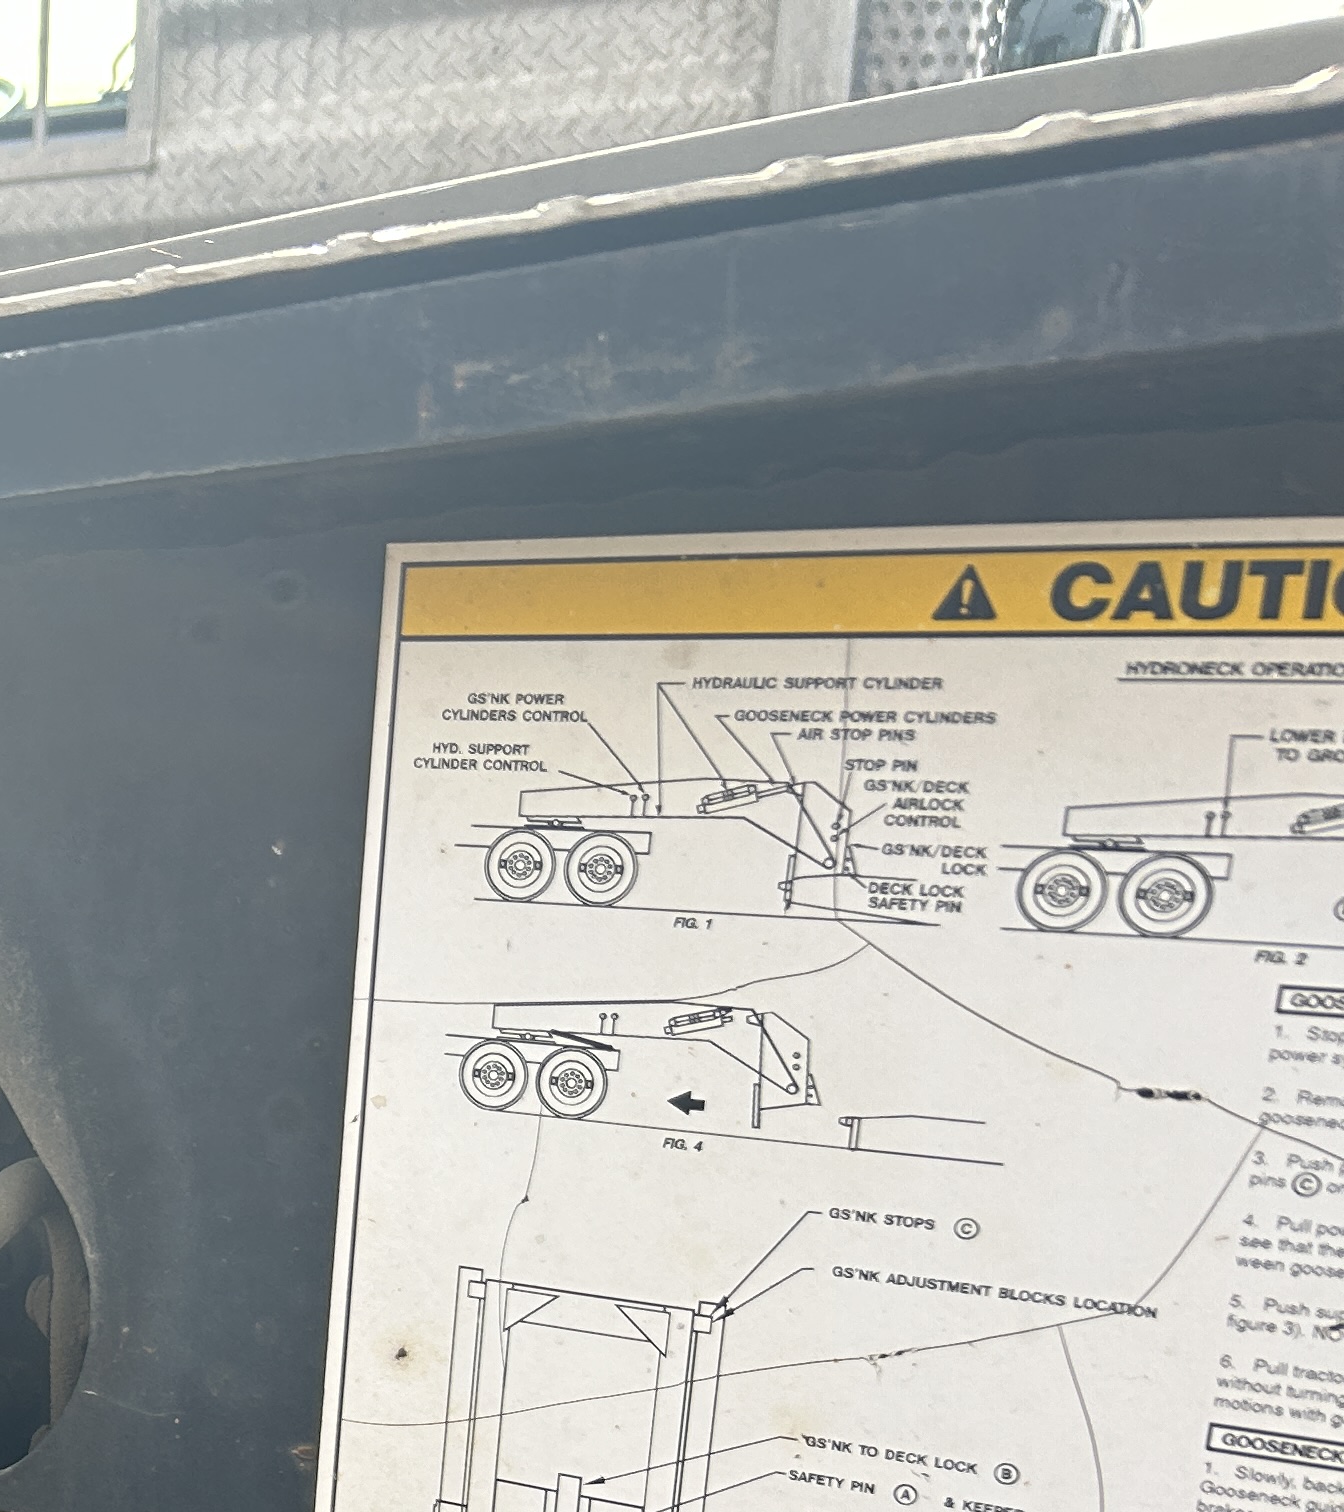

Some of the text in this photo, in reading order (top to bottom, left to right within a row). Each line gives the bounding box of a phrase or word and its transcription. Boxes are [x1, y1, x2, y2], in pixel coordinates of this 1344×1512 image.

[1050, 559, 1344, 622] CAUTI
[1126, 660, 1244, 676] HYDRONECK
[692, 677, 944, 690] HYDRAULIC SUPPORT CYLINDER
[515, 693, 565, 706] POWER
[442, 709, 588, 722] CYLINDERS CONTROL
[734, 710, 998, 725] GOOSENECK POWER CYLINDERS
[796, 729, 917, 742] AIR STOP PINS
[1269, 728, 1335, 744] LOWER
[467, 744, 530, 755] SUPPORT
[413, 757, 548, 772] CYLINDER CONTROL
[844, 759, 918, 772] STOP PIN
[892, 798, 965, 811] AIRLOCK
[883, 814, 962, 829] CONTROL
[941, 863, 988, 876] LOCK
[868, 881, 965, 899] DECK LOCK
[867, 897, 962, 913] SAFETY PIN
[706, 919, 713, 929] 1
[693, 1141, 703, 1153] 4
[1287, 1153, 1334, 1172] Push
[884, 1214, 935, 1231] STOPS
[886, 1274, 992, 1297] ADJUSTMENT
[998, 1288, 1066, 1307] BLOCKS
[1074, 1297, 1158, 1319] LOCATION
[1263, 1297, 1311, 1317] Push
[1213, 1396, 1284, 1417] motions
[858, 1444, 878, 1457] TO
[885, 1449, 928, 1467] DECK
[934, 1457, 978, 1475] LOCK
[789, 1470, 845, 1489] SAFETY
[851, 1480, 875, 1495] PIN
[1199, 1479, 1301, 1509] Gooseneck
